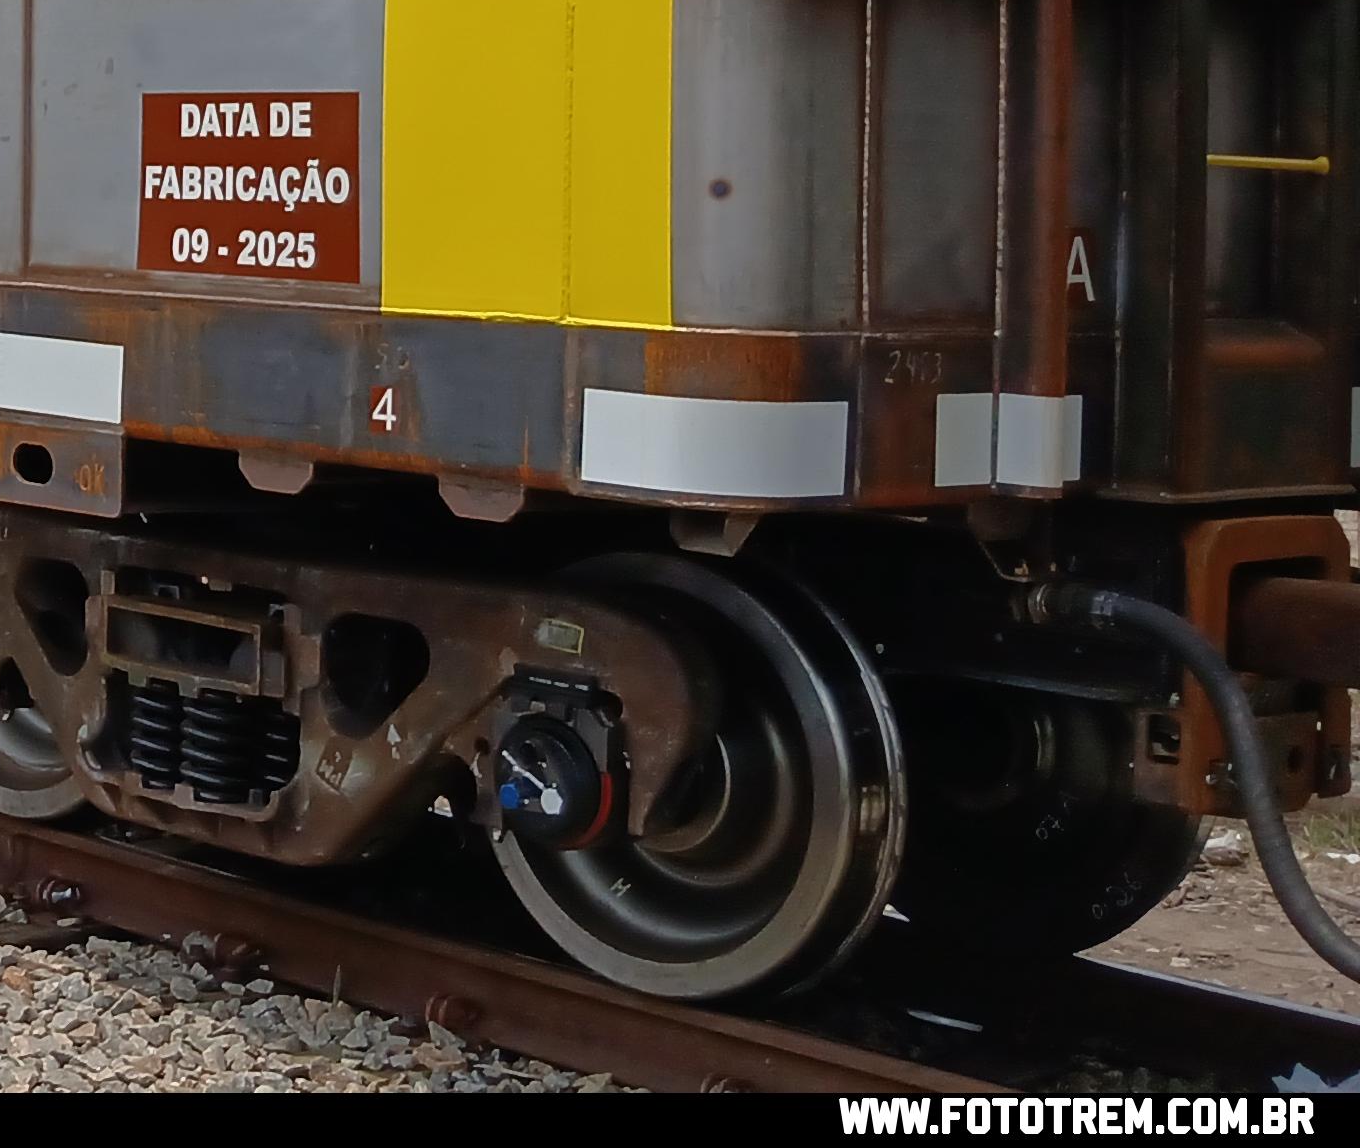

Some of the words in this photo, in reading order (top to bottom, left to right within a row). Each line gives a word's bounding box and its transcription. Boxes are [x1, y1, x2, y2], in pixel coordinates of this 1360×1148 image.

[180, 102, 260, 138] DATA
[269, 101, 312, 138] DE
[144, 158, 350, 212] FABRICAÇÃO
[171, 227, 209, 264] 09
[236, 229, 317, 269] 2025
[1066, 235, 1096, 302] A
[371, 387, 397, 431] 4
